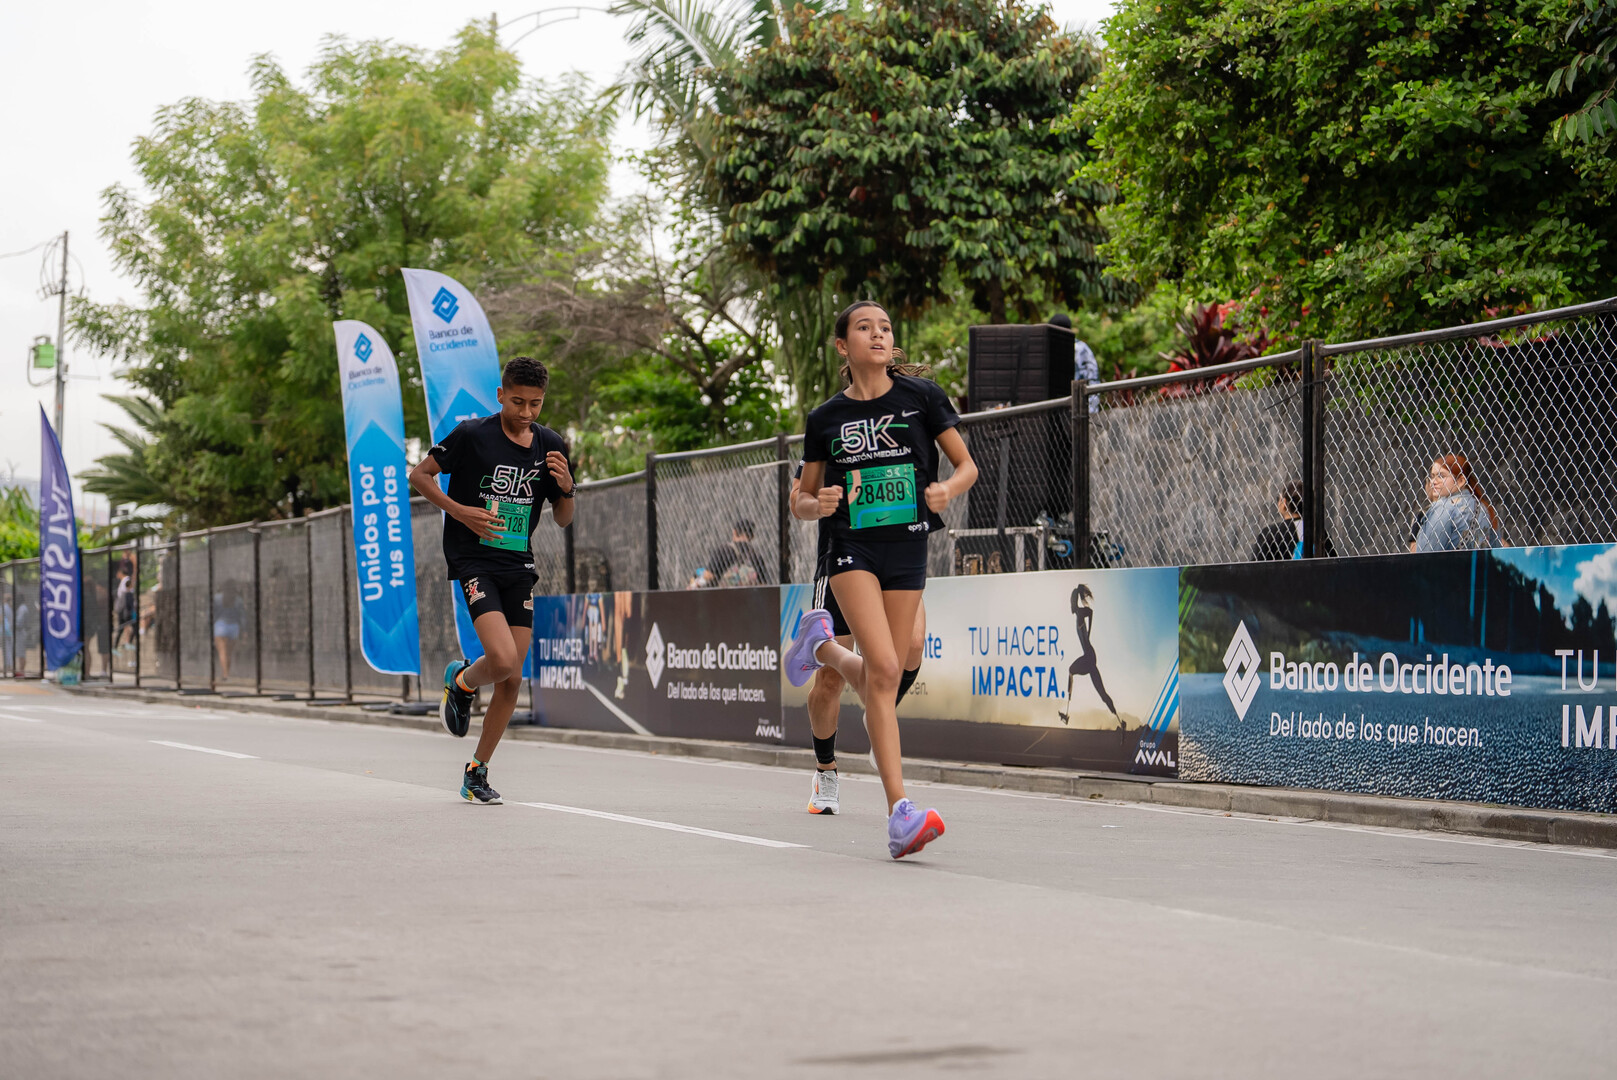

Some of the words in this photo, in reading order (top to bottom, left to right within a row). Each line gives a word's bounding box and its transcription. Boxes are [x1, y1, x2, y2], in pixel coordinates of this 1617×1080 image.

[428, 329, 459, 340] Banco
[460, 325, 474, 336] de
[429, 338, 478, 353] Occidente
[348, 367, 373, 380] Banco
[373, 365, 382, 375] de
[348, 376, 386, 391] Occidente
[841, 414, 899, 454] 5K
[835, 451, 873, 465] MARATÓN
[873, 446, 912, 459] MEDELLÍN
[359, 463, 381, 507] por
[490, 464, 540, 497] 5K
[855, 480, 905, 506] 28489
[383, 464, 403, 543] metas
[478, 491, 512, 504] MARATÓN
[360, 512, 384, 602] Unidos
[389, 548, 405, 589] tus
[538, 638, 550, 662] TU
[552, 638, 586, 665] HACER,
[667, 643, 701, 670] Banco
[701, 642, 717, 670] de
[717, 642, 778, 671] Occidente
[968, 626, 990, 656] TU
[998, 625, 1065, 661] HACER,
[540, 666, 586, 691] IMPACTA.
[971, 665, 1066, 699] IMPACTA.
[1269, 651, 1339, 693] Banco
[1343, 651, 1374, 693] de
[1378, 652, 1513, 697] Occidente
[1554, 649, 1599, 692] TU
[667, 681, 681, 699] Del
[681, 682, 697, 700] lado
[697, 683, 708, 700] de
[708, 682, 722, 701] los
[721, 686, 737, 705] que
[737, 682, 766, 703] hacen.
[755, 724, 782, 739] AVAL
[1269, 711, 1294, 738] Del
[1297, 712, 1334, 739] lado
[1335, 713, 1356, 739] de
[1359, 714, 1383, 741] los
[1387, 722, 1419, 750] que
[1423, 717, 1484, 748] hacen.
[1139, 739, 1156, 750] Grupo
[1134, 749, 1176, 768] AVAL
